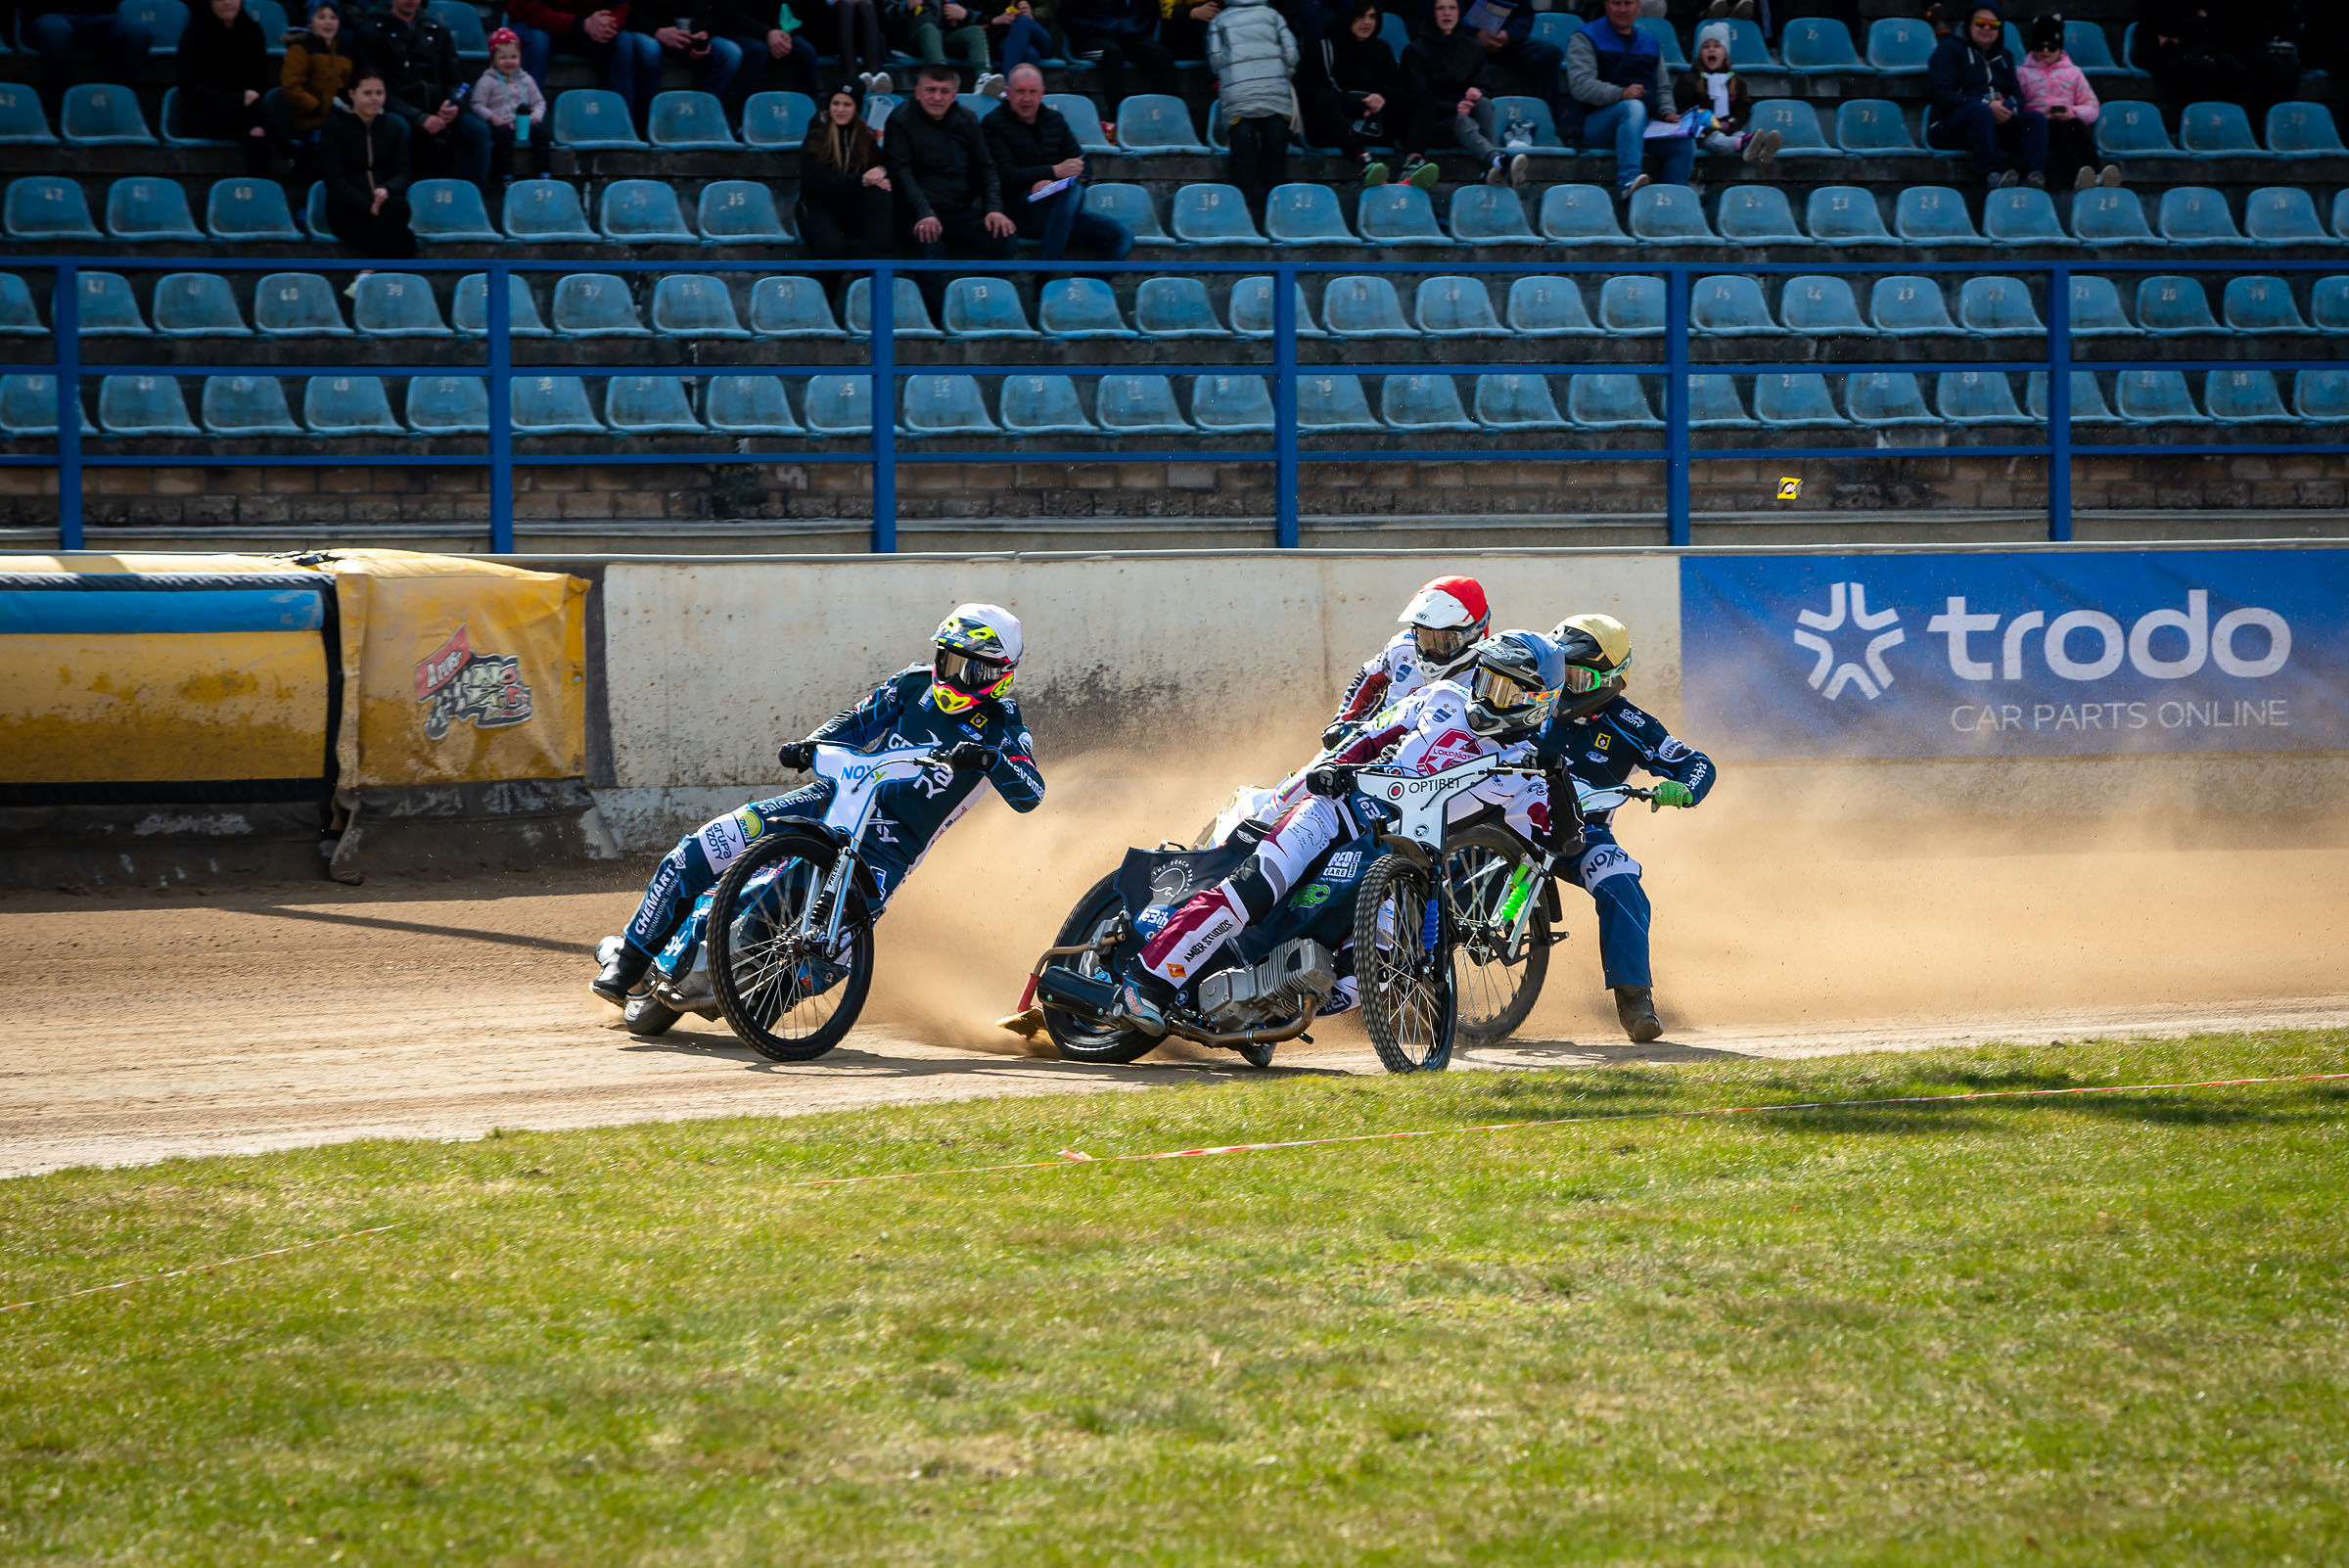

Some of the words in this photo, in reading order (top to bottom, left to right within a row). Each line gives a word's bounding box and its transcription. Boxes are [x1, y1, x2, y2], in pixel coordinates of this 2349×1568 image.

[1927, 589, 2292, 680] trodo
[1951, 705, 2022, 732] CAR
[2035, 702, 2147, 731] PARTS
[2158, 700, 2289, 728] ONLINE
[1409, 777, 1461, 794] OPTIBET
[635, 864, 675, 935] CHEMART
[1184, 943, 1208, 963] AMBER
